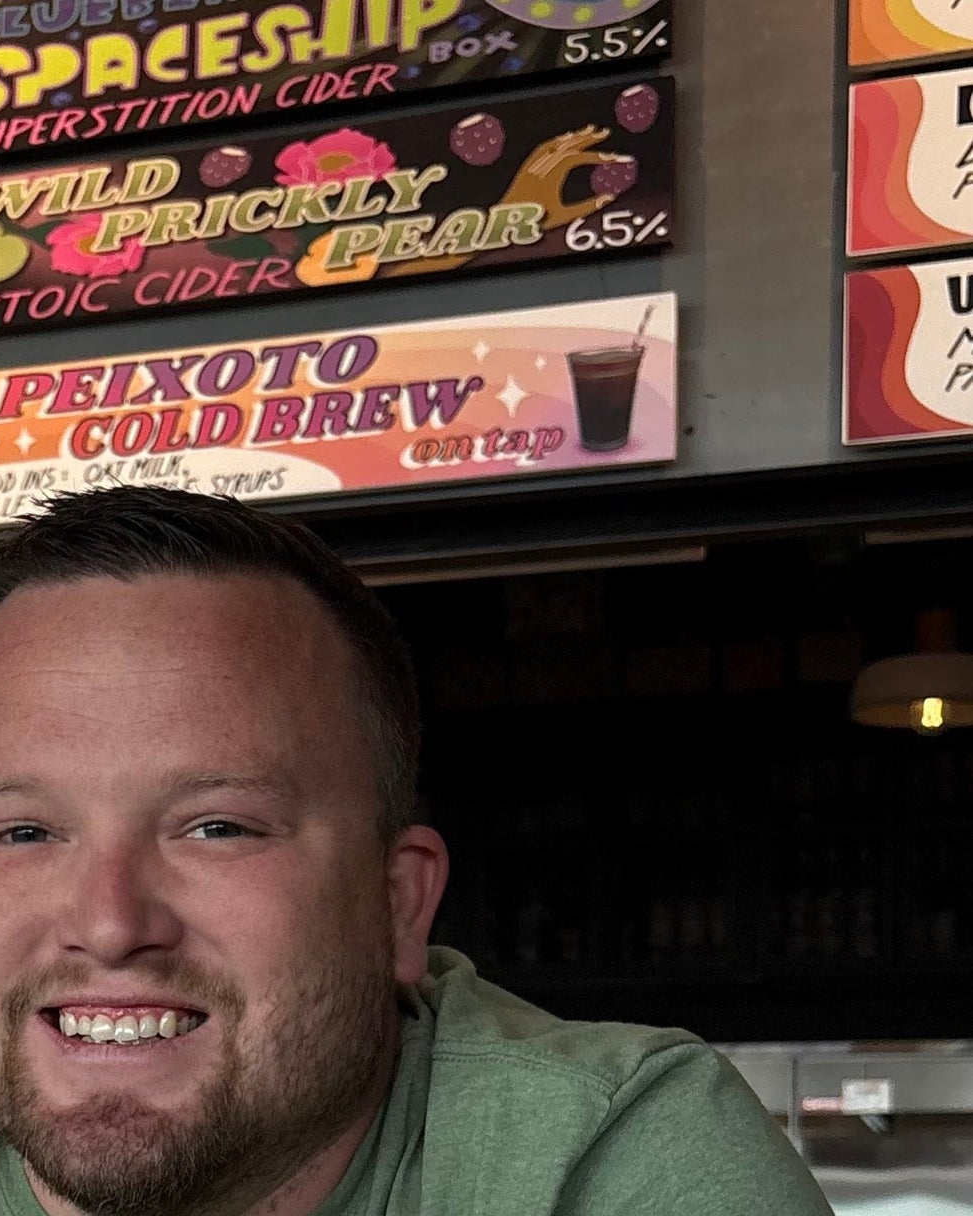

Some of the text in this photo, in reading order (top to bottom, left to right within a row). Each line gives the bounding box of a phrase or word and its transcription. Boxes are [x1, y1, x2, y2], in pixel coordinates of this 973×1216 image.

[427, 30, 520, 65] BOX
[564, 19, 668, 64] 5.5%
[276, 63, 399, 108] CIDER
[90, 164, 449, 253] PRICKLY
[564, 210, 669, 251] 6.5%
[324, 202, 547, 270] PEAR
[133, 256, 293, 307] CIDER
[69, 375, 485, 460] COLD BREW
[410, 426, 565, 464] on tap
